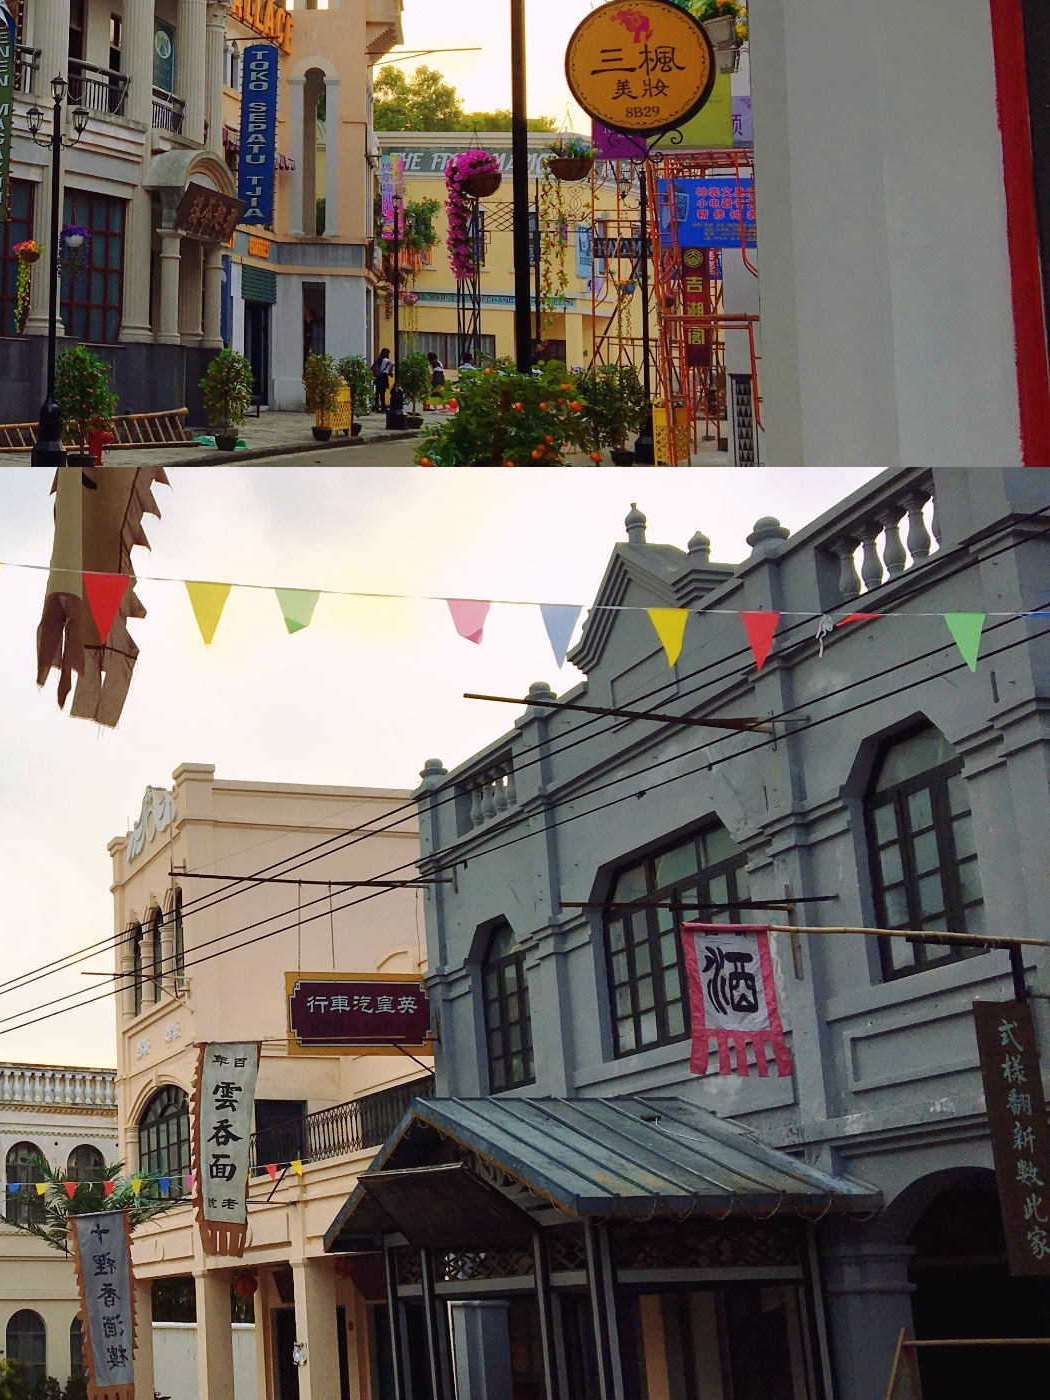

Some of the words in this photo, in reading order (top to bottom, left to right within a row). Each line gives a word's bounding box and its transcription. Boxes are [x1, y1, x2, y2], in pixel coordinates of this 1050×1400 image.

[248, 51, 269, 91] TOKO
[591, 43, 686, 76] 三楓
[625, 106, 659, 118] 8B29
[245, 102, 267, 164] SEPATU
[243, 176, 265, 218] TJIA
[702, 946, 758, 1015] 酒
